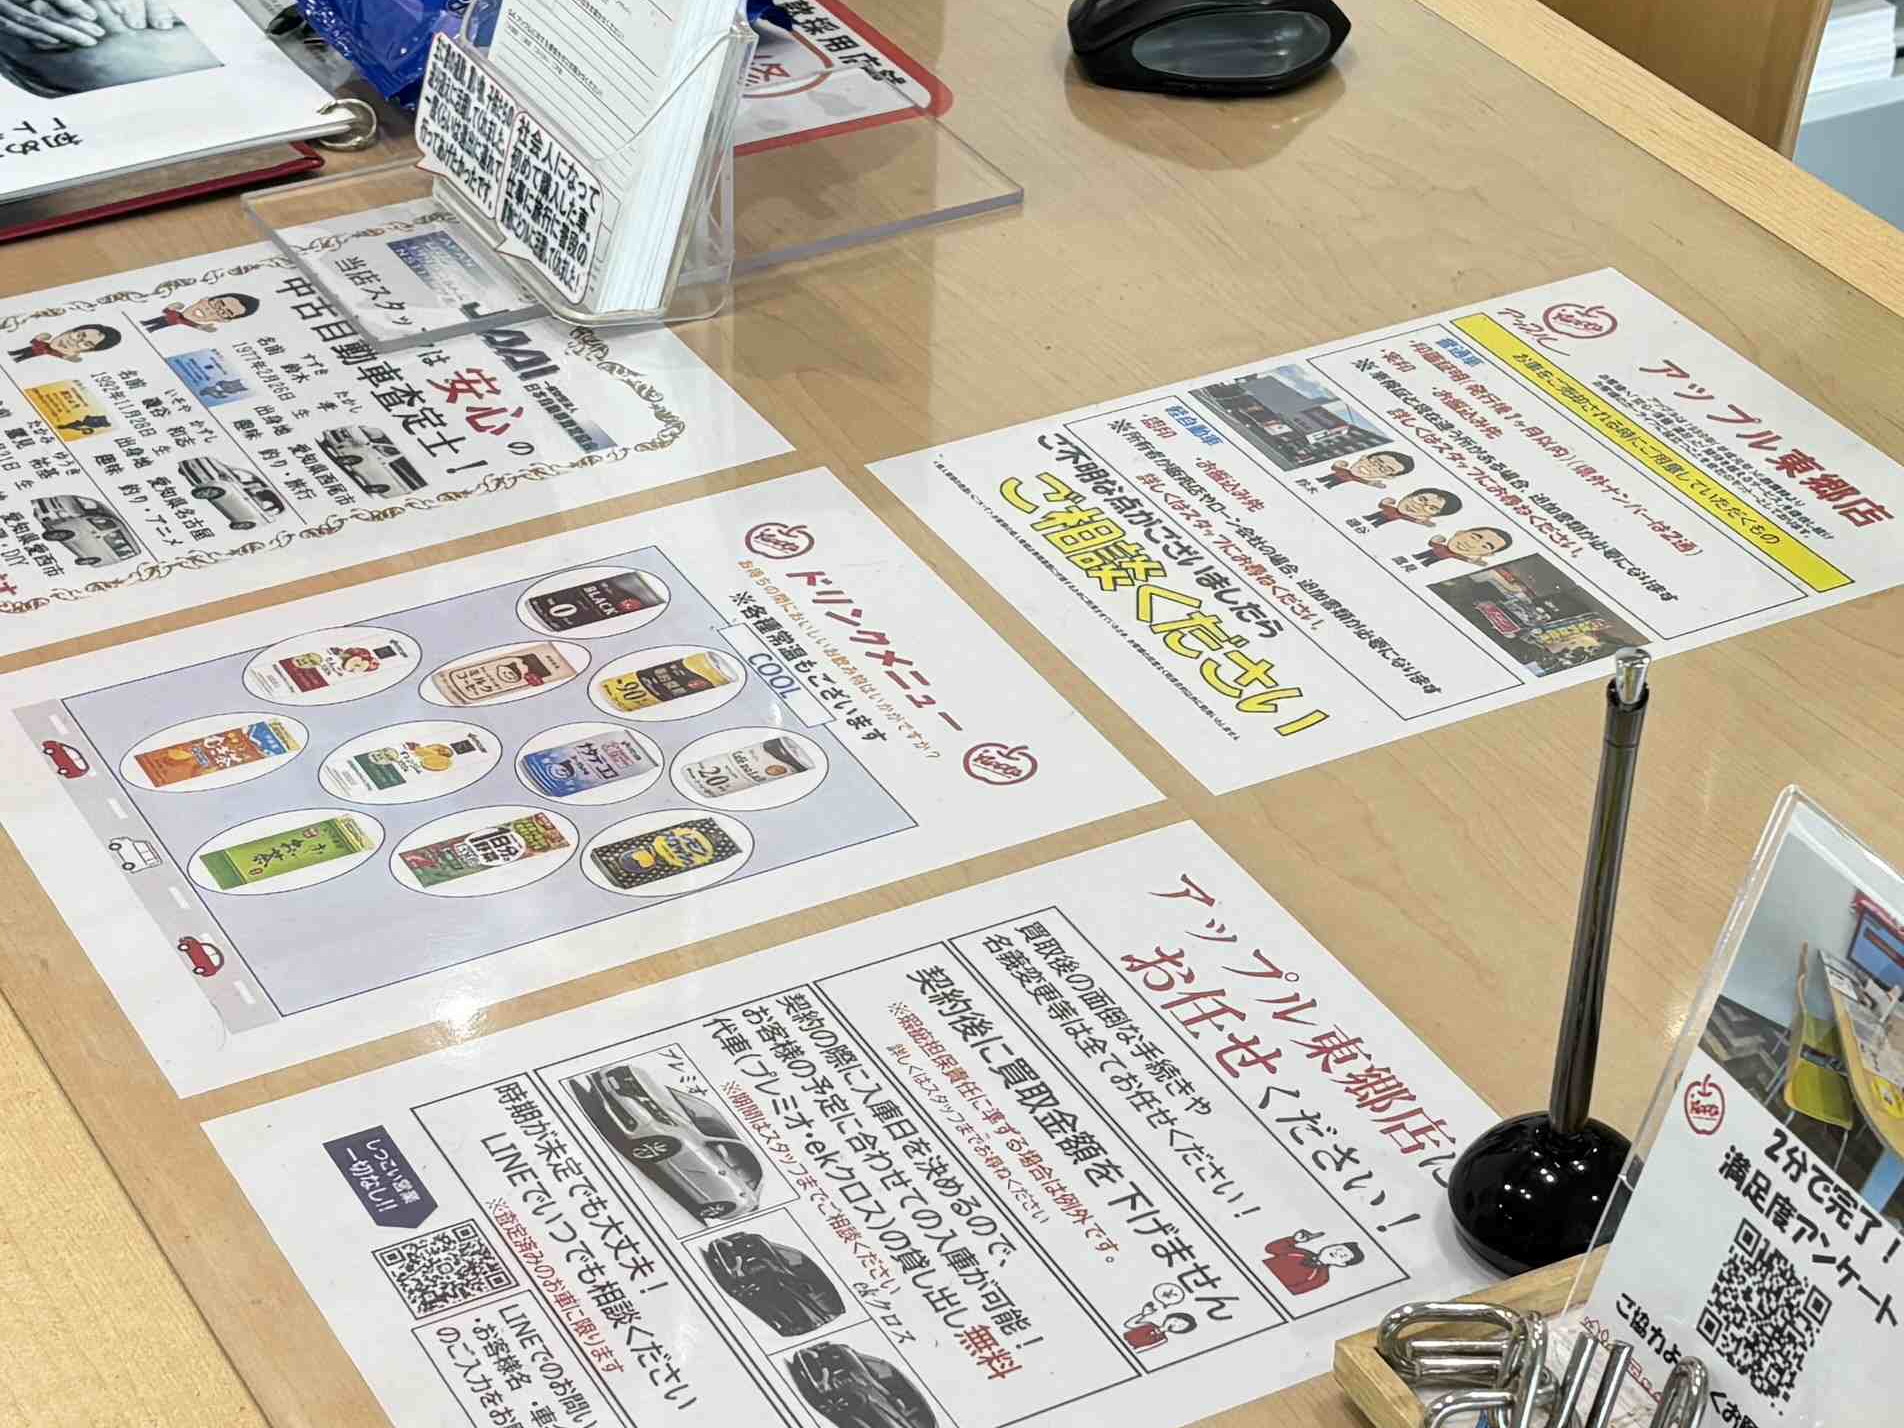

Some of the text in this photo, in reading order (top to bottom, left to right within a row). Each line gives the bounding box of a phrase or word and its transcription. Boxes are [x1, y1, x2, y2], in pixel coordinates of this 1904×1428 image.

[515, 113, 599, 215] 社会人になって
[115, 368, 150, 390] 名前
[229, 417, 266, 442] 趣味
[253, 334, 314, 385] 名前 鈴木
[287, 407, 314, 421] 生
[11, 477, 39, 491] 生
[89, 451, 127, 477] 趣味
[110, 434, 216, 543] 出身地 愛知県名古屋
[147, 443, 175, 457] 生
[250, 403, 358, 508] 出身地 愛知県西尾市
[1507, 352, 1785, 546] お車をご売却される時にご用意していただくもの
[1630, 358, 1899, 529] アップル東郷店
[579, 585, 619, 617] BLACK
[983, 466, 1339, 743] ご相談ください
[1031, 430, 1291, 641] ご不明な点がございましたら
[723, 589, 891, 746] ※各種常温もございます
[742, 650, 807, 700] COOL
[782, 564, 978, 737] ドリンクメニュー
[653, 1045, 712, 1100] プレミオ
[977, 931, 1265, 1223] 名義変更等は全てお任せください！
[1012, 919, 1219, 1121] 買取後の面倒な手続きや
[1114, 938, 1442, 1238] お任せください！
[360, 1137, 421, 1206] しつこい営業
[487, 1079, 672, 1298] 時期が未定でも大丈夫！
[735, 1002, 1047, 1354] お客様の予定に合わせての入庫が可能！
[772, 990, 1028, 1270] 契約の際に入庫日を決めるので、
[902, 962, 1252, 1327] 契約後に買取金額を下げません
[1762, 1125, 1903, 1271] 2分で完了！
[475, 1130, 705, 1415] LINEでいつでも相談ください
[482, 1195, 629, 1379] ※査定済みのお車に限ります
[849, 1277, 921, 1347] ekクロス
